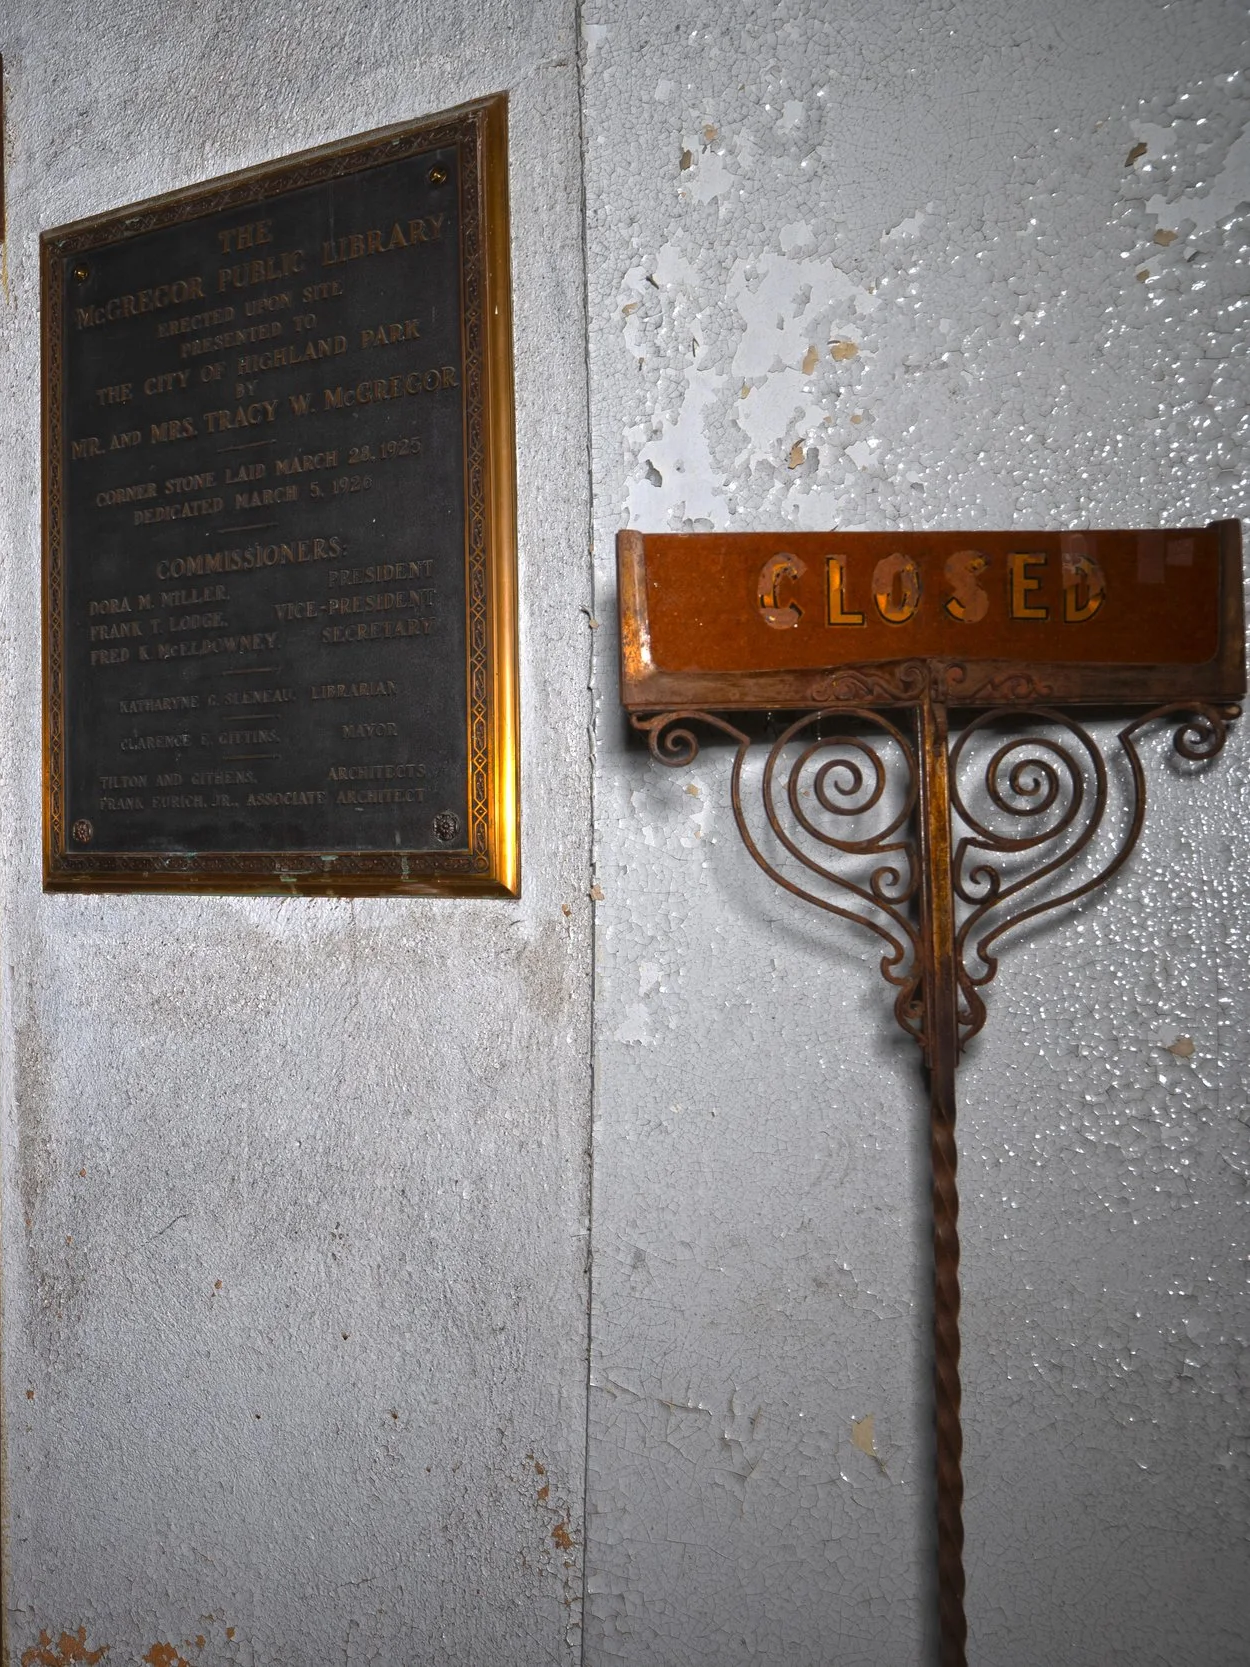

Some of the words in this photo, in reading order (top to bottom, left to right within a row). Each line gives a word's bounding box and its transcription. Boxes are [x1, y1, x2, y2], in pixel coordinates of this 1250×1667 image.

[217, 218, 274, 255] THE
[75, 276, 206, 331] McGREGOR
[218, 250, 306, 294] PUBLIC
[321, 212, 446, 267] LIBRARY
[156, 306, 235, 338] ERECTED
[244, 292, 292, 317] UPON
[302, 280, 344, 303] SITE
[180, 321, 283, 359] PRESENTED
[292, 313, 318, 332] TO
[95, 383, 134, 406] THE
[144, 369, 191, 396] CITY
[201, 361, 226, 383] OF
[237, 335, 348, 376] HIGHLAND
[360, 318, 421, 350] PARK
[70, 436, 106, 460] MR.
[110, 431, 142, 449] AND
[150, 416, 198, 444] MRS.
[203, 399, 278, 434] TRACY
[289, 391, 318, 416] W.
[323, 366, 459, 411] McGREGOR
[235, 379, 258, 400] BY
[96, 483, 158, 508] CORNER
[165, 472, 217, 494] STONE
[225, 463, 267, 484] LAID
[275, 450, 339, 476] MARCH
[380, 436, 422, 460] 1925
[134, 497, 225, 526] DEDICATED
[235, 485, 298, 509] MARCH
[332, 474, 373, 495] 1926
[156, 536, 348, 580] COMMISSIONERS:
[90, 596, 132, 616] DORA
[137, 593, 155, 611] M.
[328, 559, 434, 588] PRESIDENT
[756, 550, 1107, 630] CLOSED
[90, 621, 142, 641] FRANK
[273, 588, 437, 620] VICE-PRESIDENT
[90, 647, 130, 666] FRED
[321, 616, 436, 643] SECRETARY
[310, 680, 397, 700] LIBRARIAN
[120, 733, 193, 751] CLARENCE
[341, 722, 398, 739] MAYOR
[100, 796, 145, 812] FRANK
[246, 790, 327, 807] ASSOCIATE
[336, 788, 425, 804] ARCHITECT
[155, 772, 183, 787] AND
[327, 763, 426, 782] ARCHITECTS
